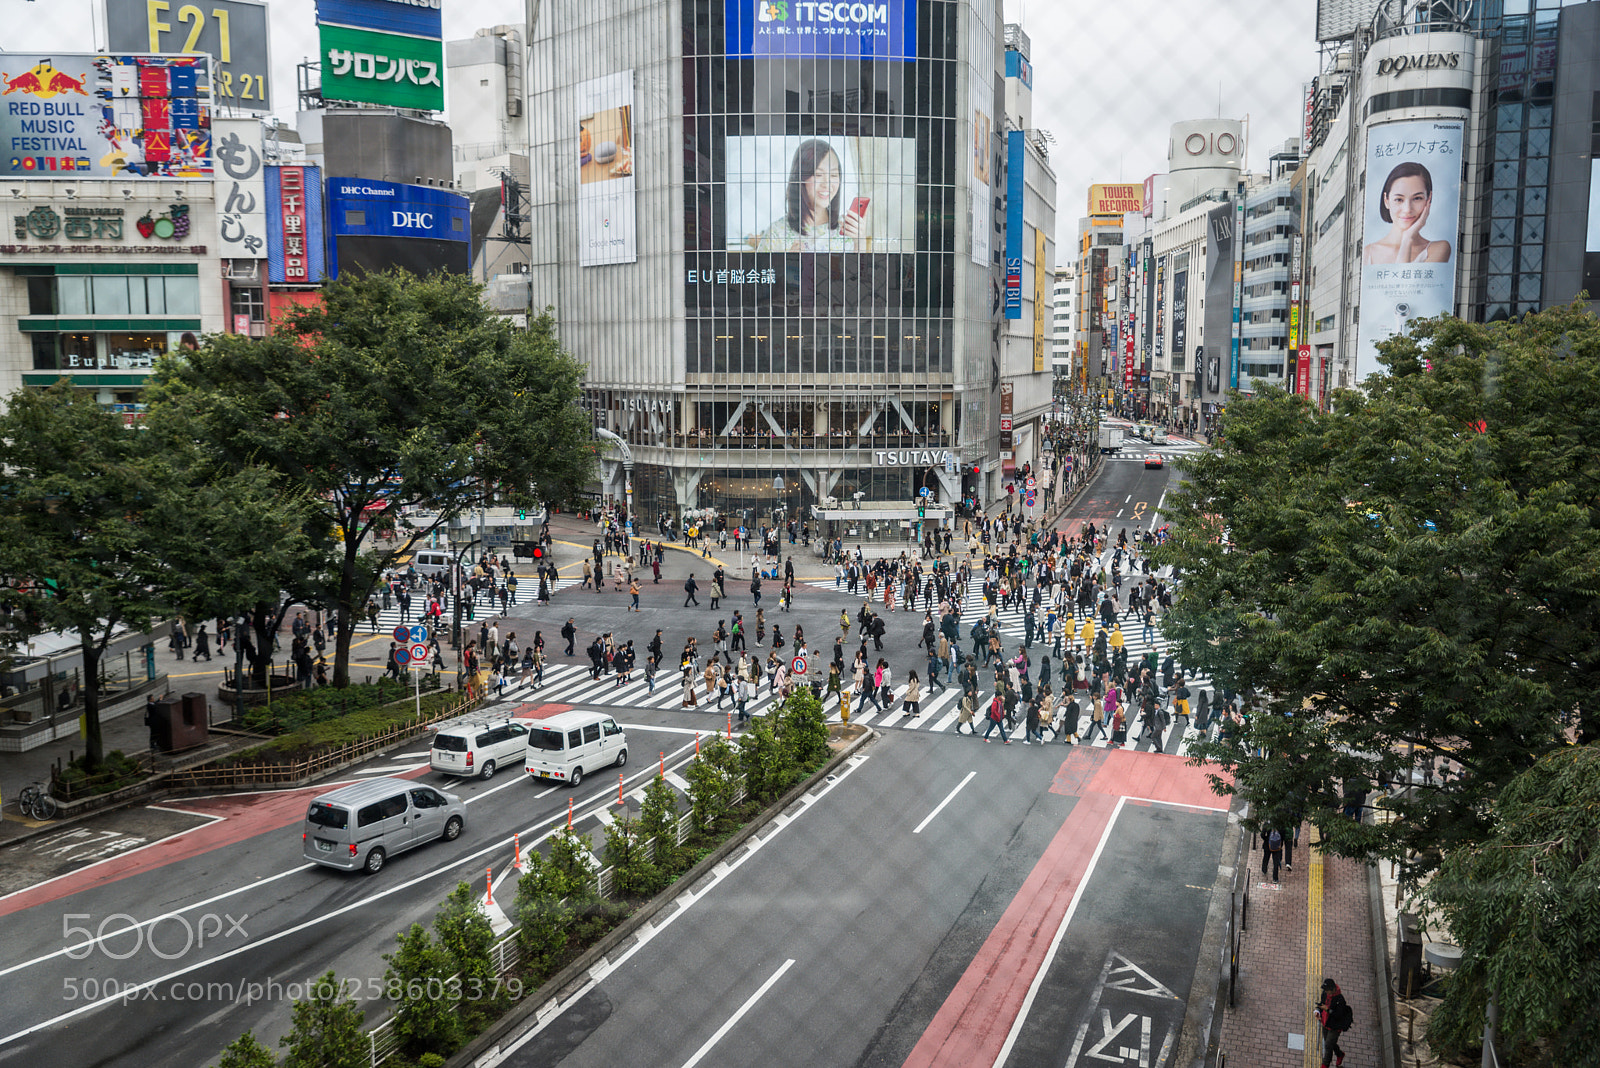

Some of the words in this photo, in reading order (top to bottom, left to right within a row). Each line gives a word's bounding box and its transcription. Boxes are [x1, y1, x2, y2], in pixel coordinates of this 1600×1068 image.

[795, 3, 887, 23] iTSCOM
[328, 48, 441, 87] サロンパス
[9, 102, 41, 116] RED
[45, 102, 84, 116] BULL
[21, 119, 75, 134] MUSIC
[12, 137, 87, 151] FESTIVAL
[1375, 140, 1454, 158] 私をリフトする。
[10, 157, 57, 171] 2017
[216, 132, 263, 254] もんじゃ
[341, 186, 360, 195] DHC
[362, 187, 395, 197] Channel
[1102, 186, 1134, 199] TOWER
[1099, 200, 1140, 213] RECORDS
[64, 216, 124, 240] 西村
[282, 170, 305, 278] 三千里薬品
[391, 211, 433, 229] DHC
[688, 268, 776, 285] EU首脳会議
[622, 398, 672, 413] TSUTAYA
[876, 450, 949, 466] TSUTAYA
